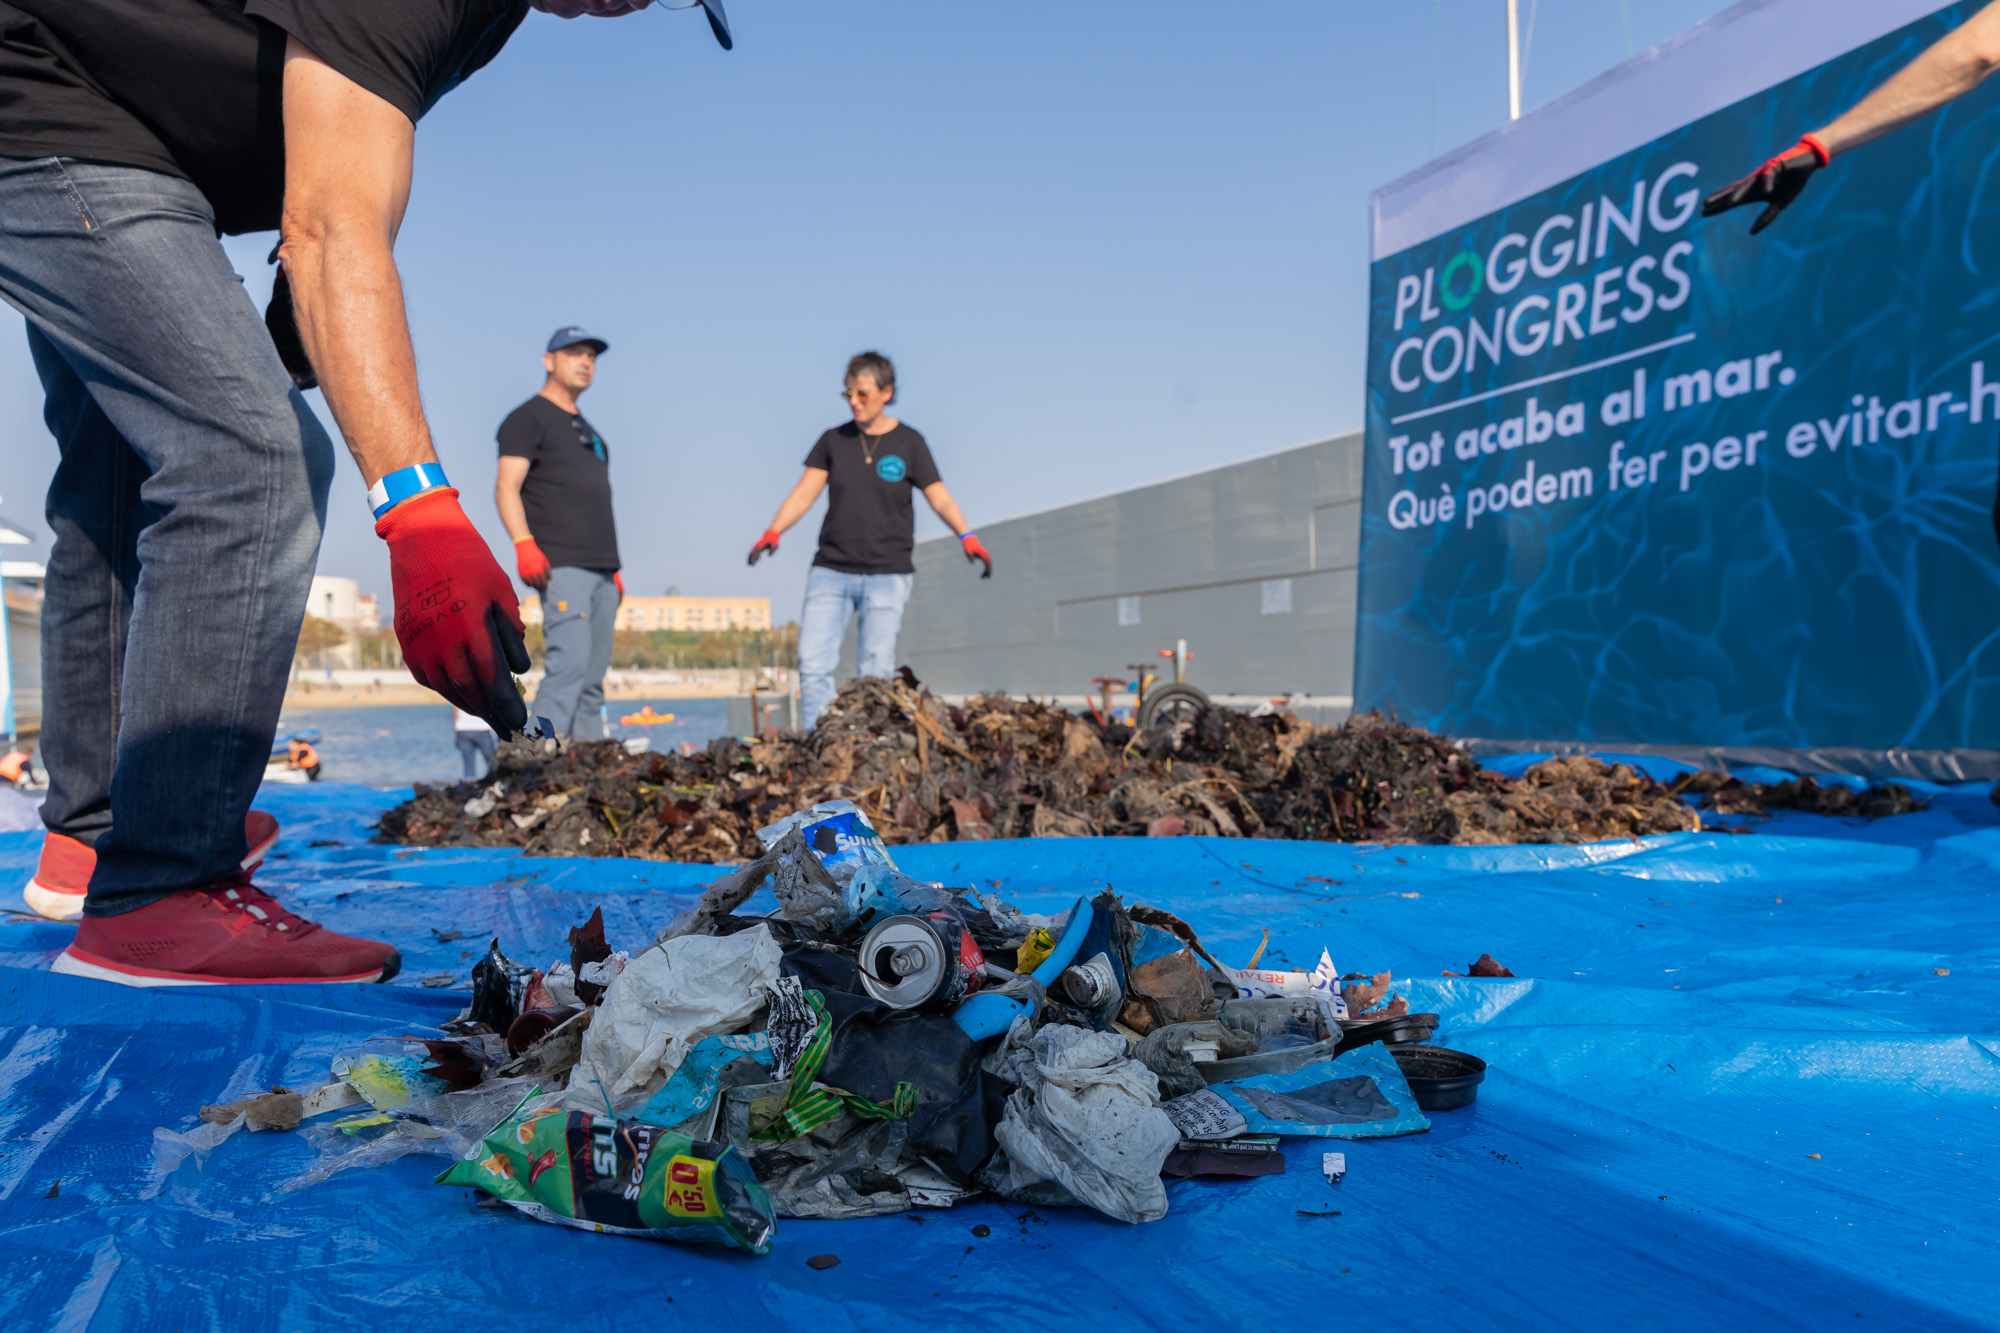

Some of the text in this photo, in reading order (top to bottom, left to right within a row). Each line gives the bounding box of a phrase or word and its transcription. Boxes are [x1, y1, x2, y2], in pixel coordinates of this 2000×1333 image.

[1393, 161, 1700, 331] PLOGGING
[1390, 241, 1693, 394] CONGRESS
[1388, 350, 1796, 475] Tot acaba al mar.
[1387, 483, 1456, 530] Què
[1466, 459, 1593, 529] podem
[1609, 440, 1667, 491] fer
[1681, 431, 1767, 491] per
[1231, 970, 1285, 985] RETAIL
[591, 1115, 618, 1179] ITS
[624, 1125, 653, 1201] ritos
